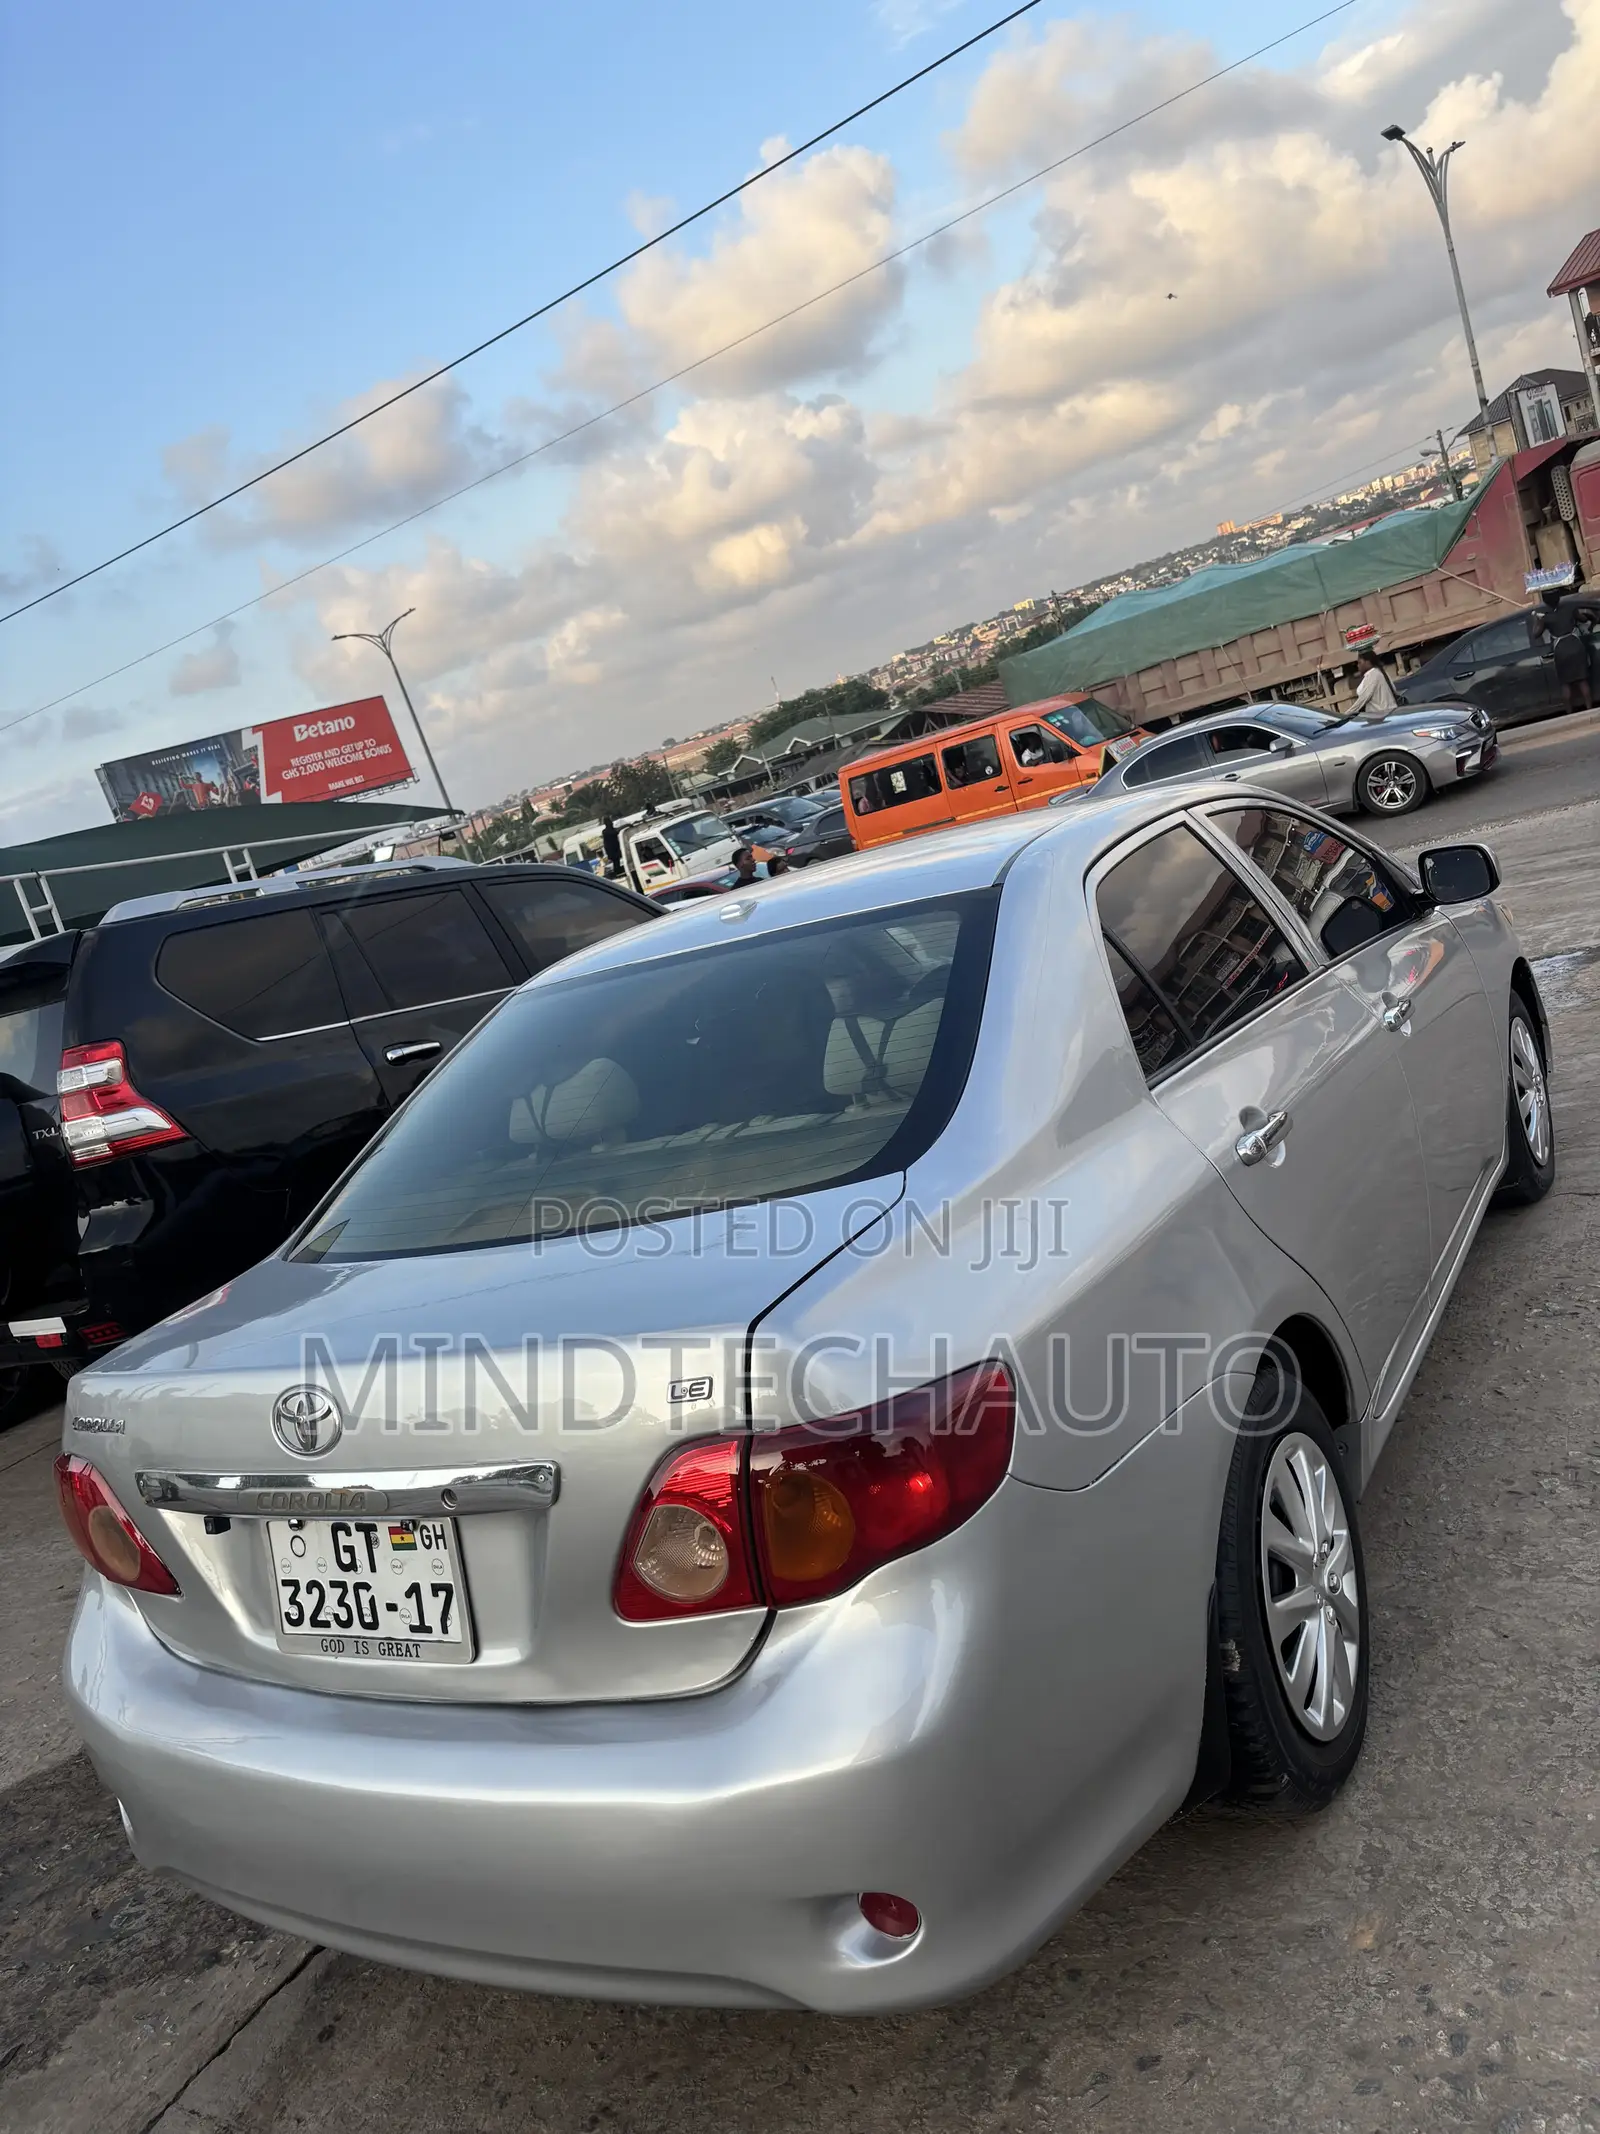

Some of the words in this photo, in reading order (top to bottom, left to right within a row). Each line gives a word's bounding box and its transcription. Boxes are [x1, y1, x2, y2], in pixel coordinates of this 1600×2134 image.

[293, 715, 355, 742] Betano
[151, 754, 180, 766] BELIEVING
[181, 749, 199, 758] MAKES
[207, 743, 221, 751] REAL
[282, 767, 300, 780] GHS
[299, 761, 325, 777] 2,000
[325, 750, 365, 769] WELCOME
[364, 743, 392, 759] BONUS
[290, 751, 324, 767] REGISTER
[324, 747, 341, 758] AND
[341, 744, 355, 754] GET
[354, 740, 365, 751] UP
[364, 738, 376, 747] TO
[671, 1381, 707, 1400] LE
[256, 1491, 366, 1513] COROLLA
[331, 1522, 379, 1573] GT
[419, 1523, 448, 1550] GH
[320, 1638, 345, 1653] GOD
[353, 1640, 370, 1655] IS
[378, 1641, 421, 1658] GREAT
